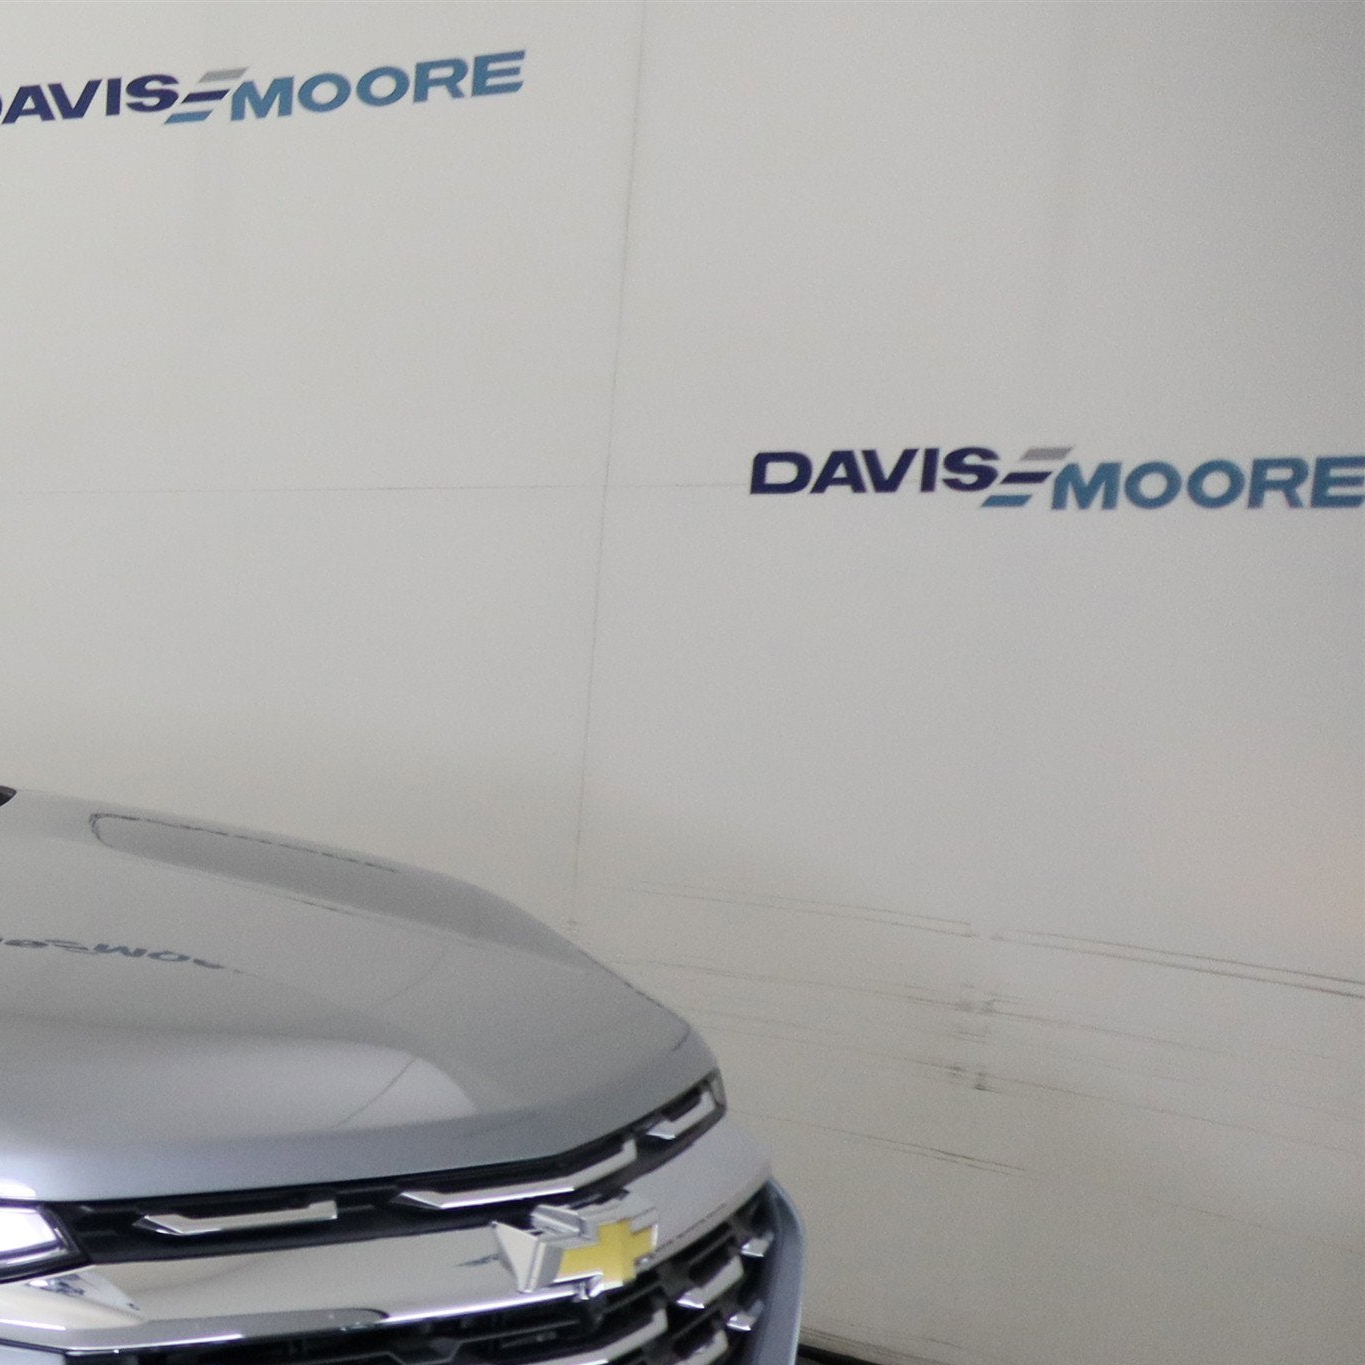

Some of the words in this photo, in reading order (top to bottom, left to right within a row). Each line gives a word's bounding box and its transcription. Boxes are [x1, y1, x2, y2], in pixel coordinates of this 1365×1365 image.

[230, 50, 526, 121] MOORE
[749, 446, 1001, 496] DAVIS
[1050, 455, 1365, 511] MOORE
